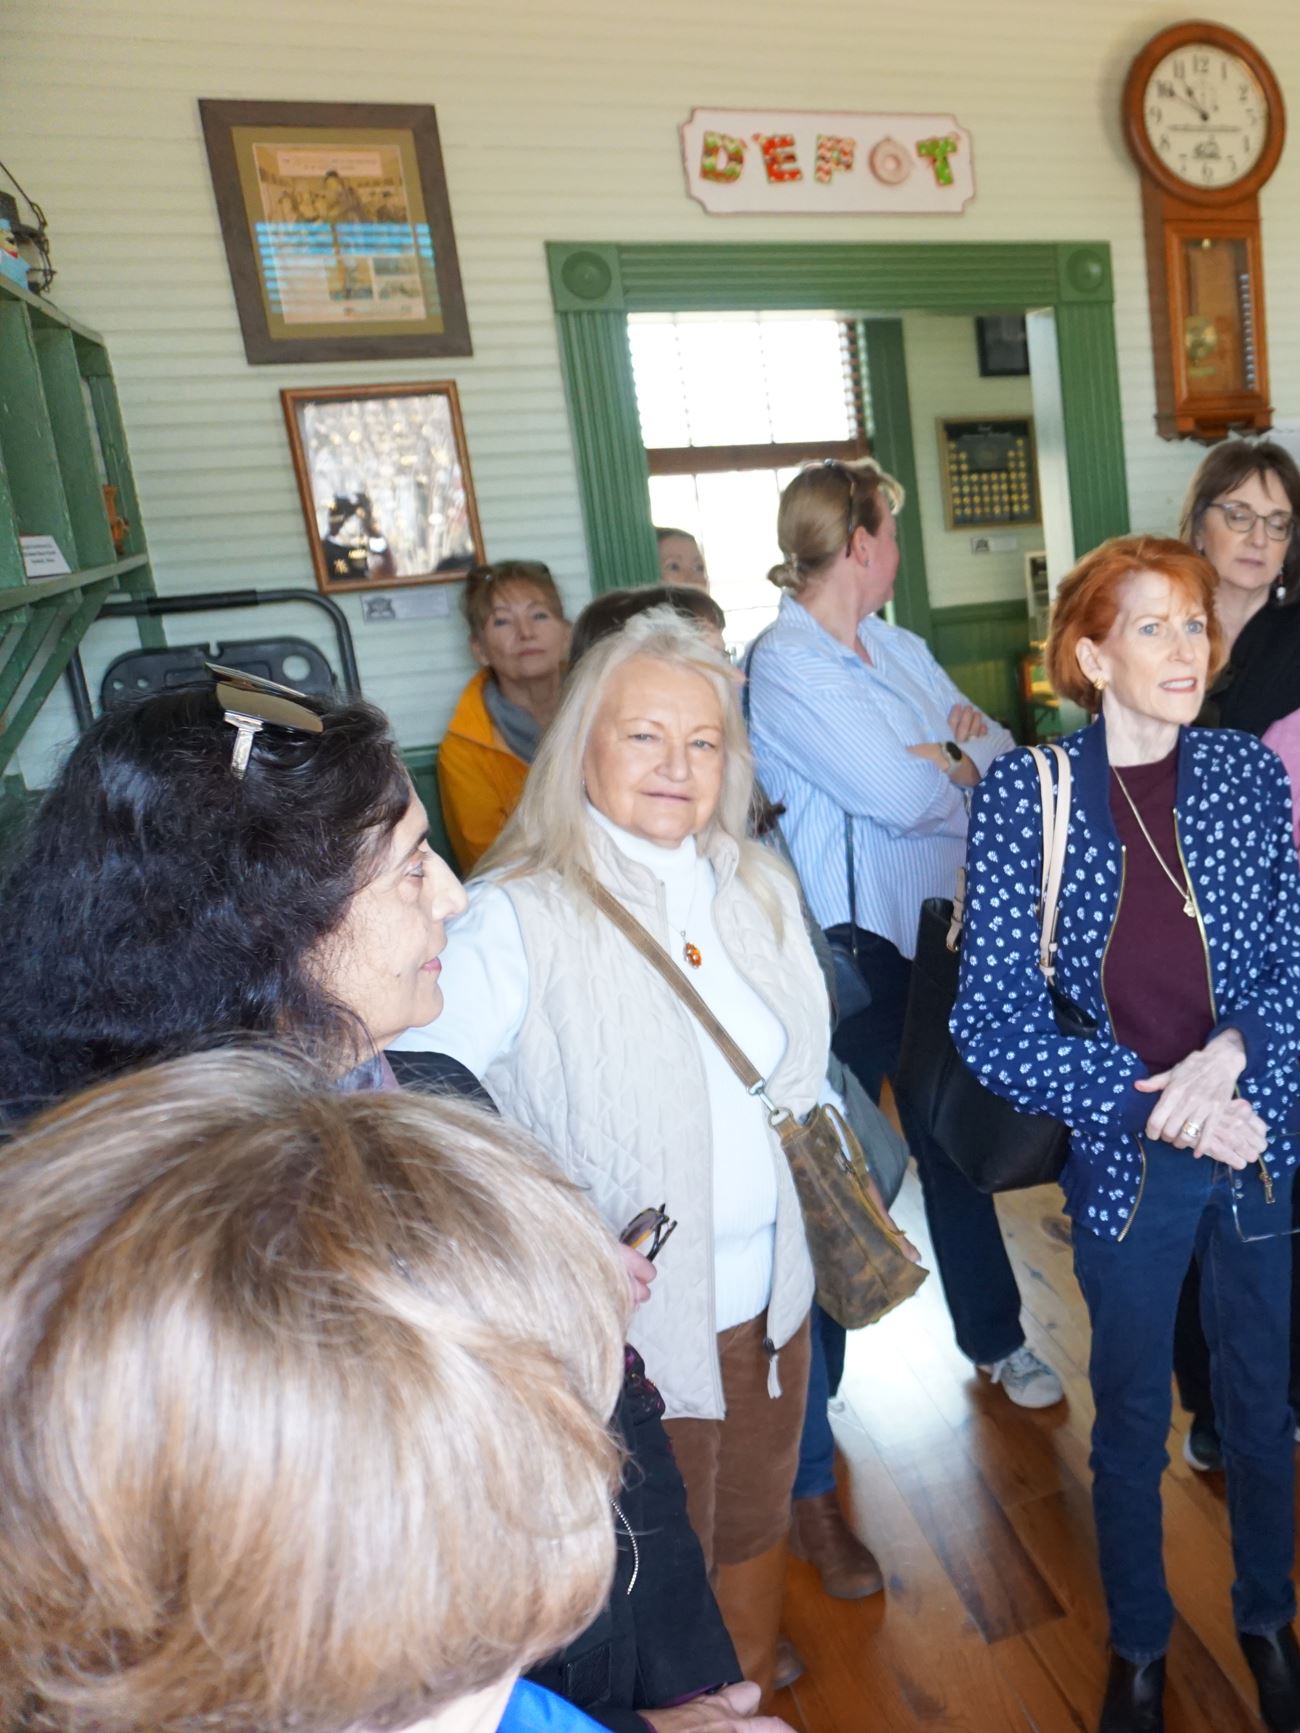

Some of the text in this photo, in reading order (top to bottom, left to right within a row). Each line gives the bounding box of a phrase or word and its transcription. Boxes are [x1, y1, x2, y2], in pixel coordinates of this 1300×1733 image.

[1173, 59, 1185, 79] 11
[1193, 54, 1209, 74] 12
[1221, 61, 1228, 80] 1
[1239, 84, 1249, 101] 2
[1149, 106, 1162, 124] 9
[700, 130, 960, 187] DEPOT
